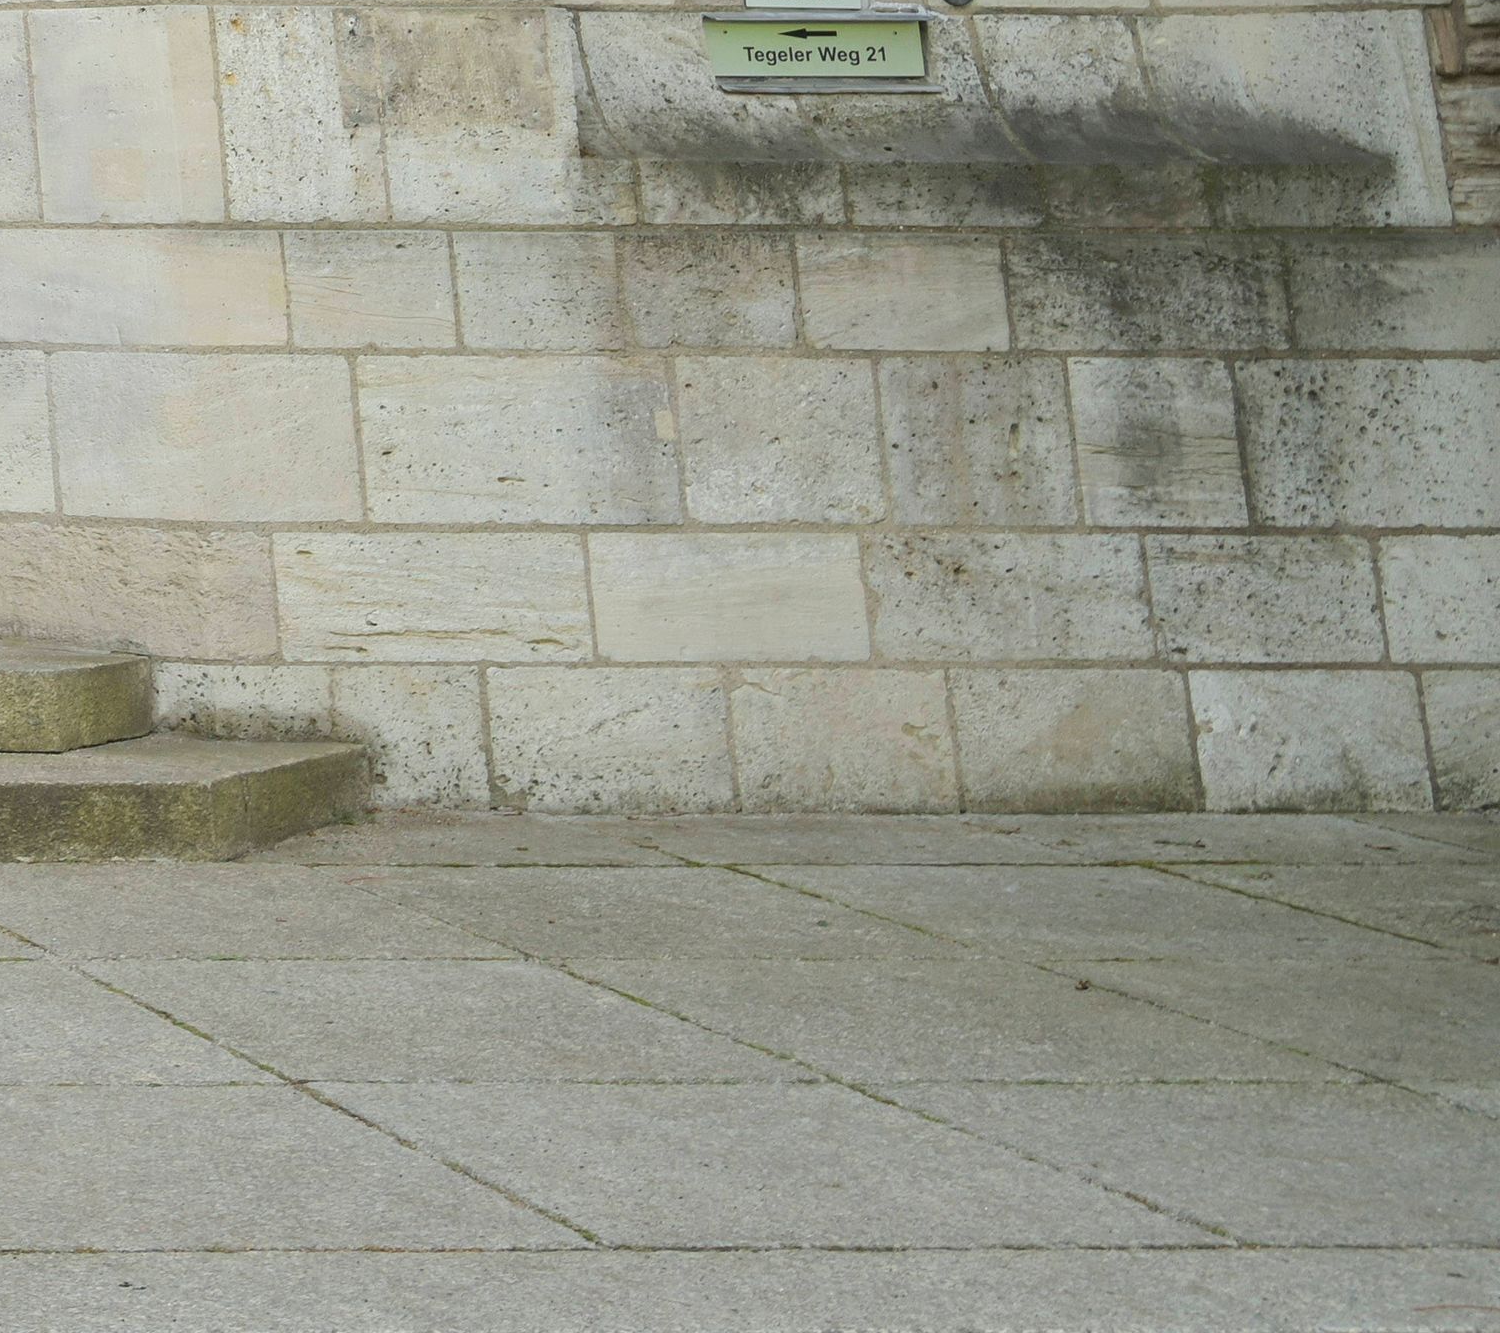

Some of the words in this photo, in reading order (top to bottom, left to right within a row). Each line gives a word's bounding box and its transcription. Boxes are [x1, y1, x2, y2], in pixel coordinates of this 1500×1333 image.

[743, 46, 813, 66] Tegeler
[817, 46, 861, 66] Weg
[866, 46, 887, 62] 21
